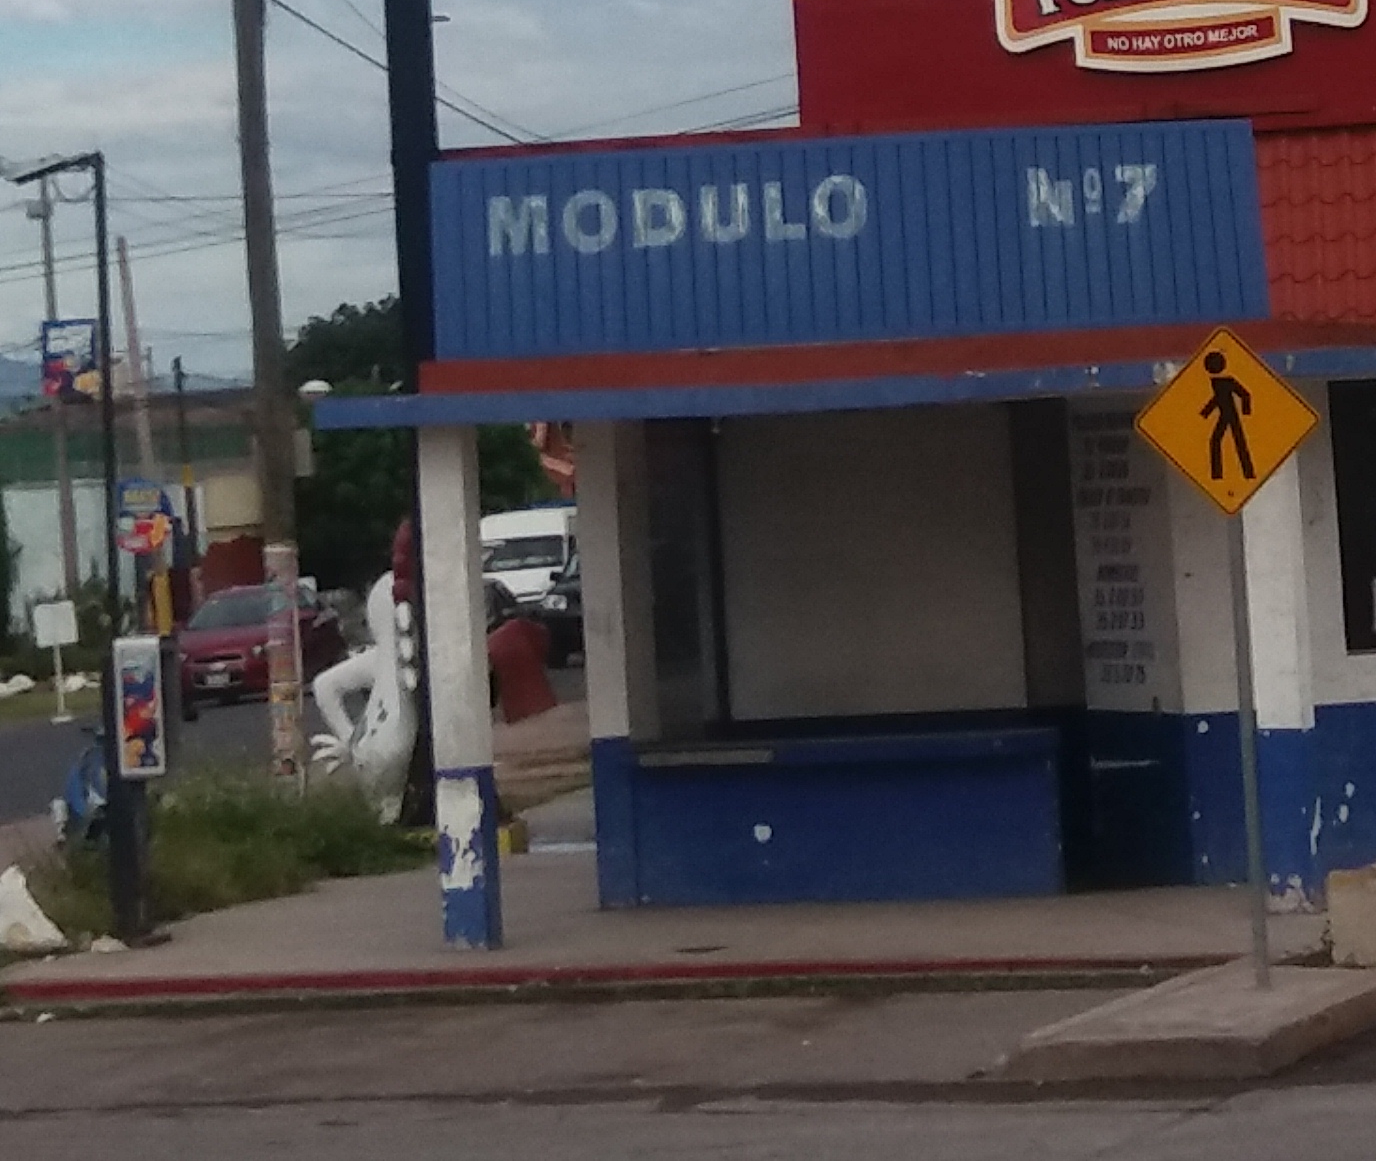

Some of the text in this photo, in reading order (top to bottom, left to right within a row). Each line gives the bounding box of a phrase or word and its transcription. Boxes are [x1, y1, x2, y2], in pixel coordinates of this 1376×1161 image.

[1106, 24, 1259, 51] NO HAY OTRO MEJOR
[488, 173, 869, 257] MODULO
